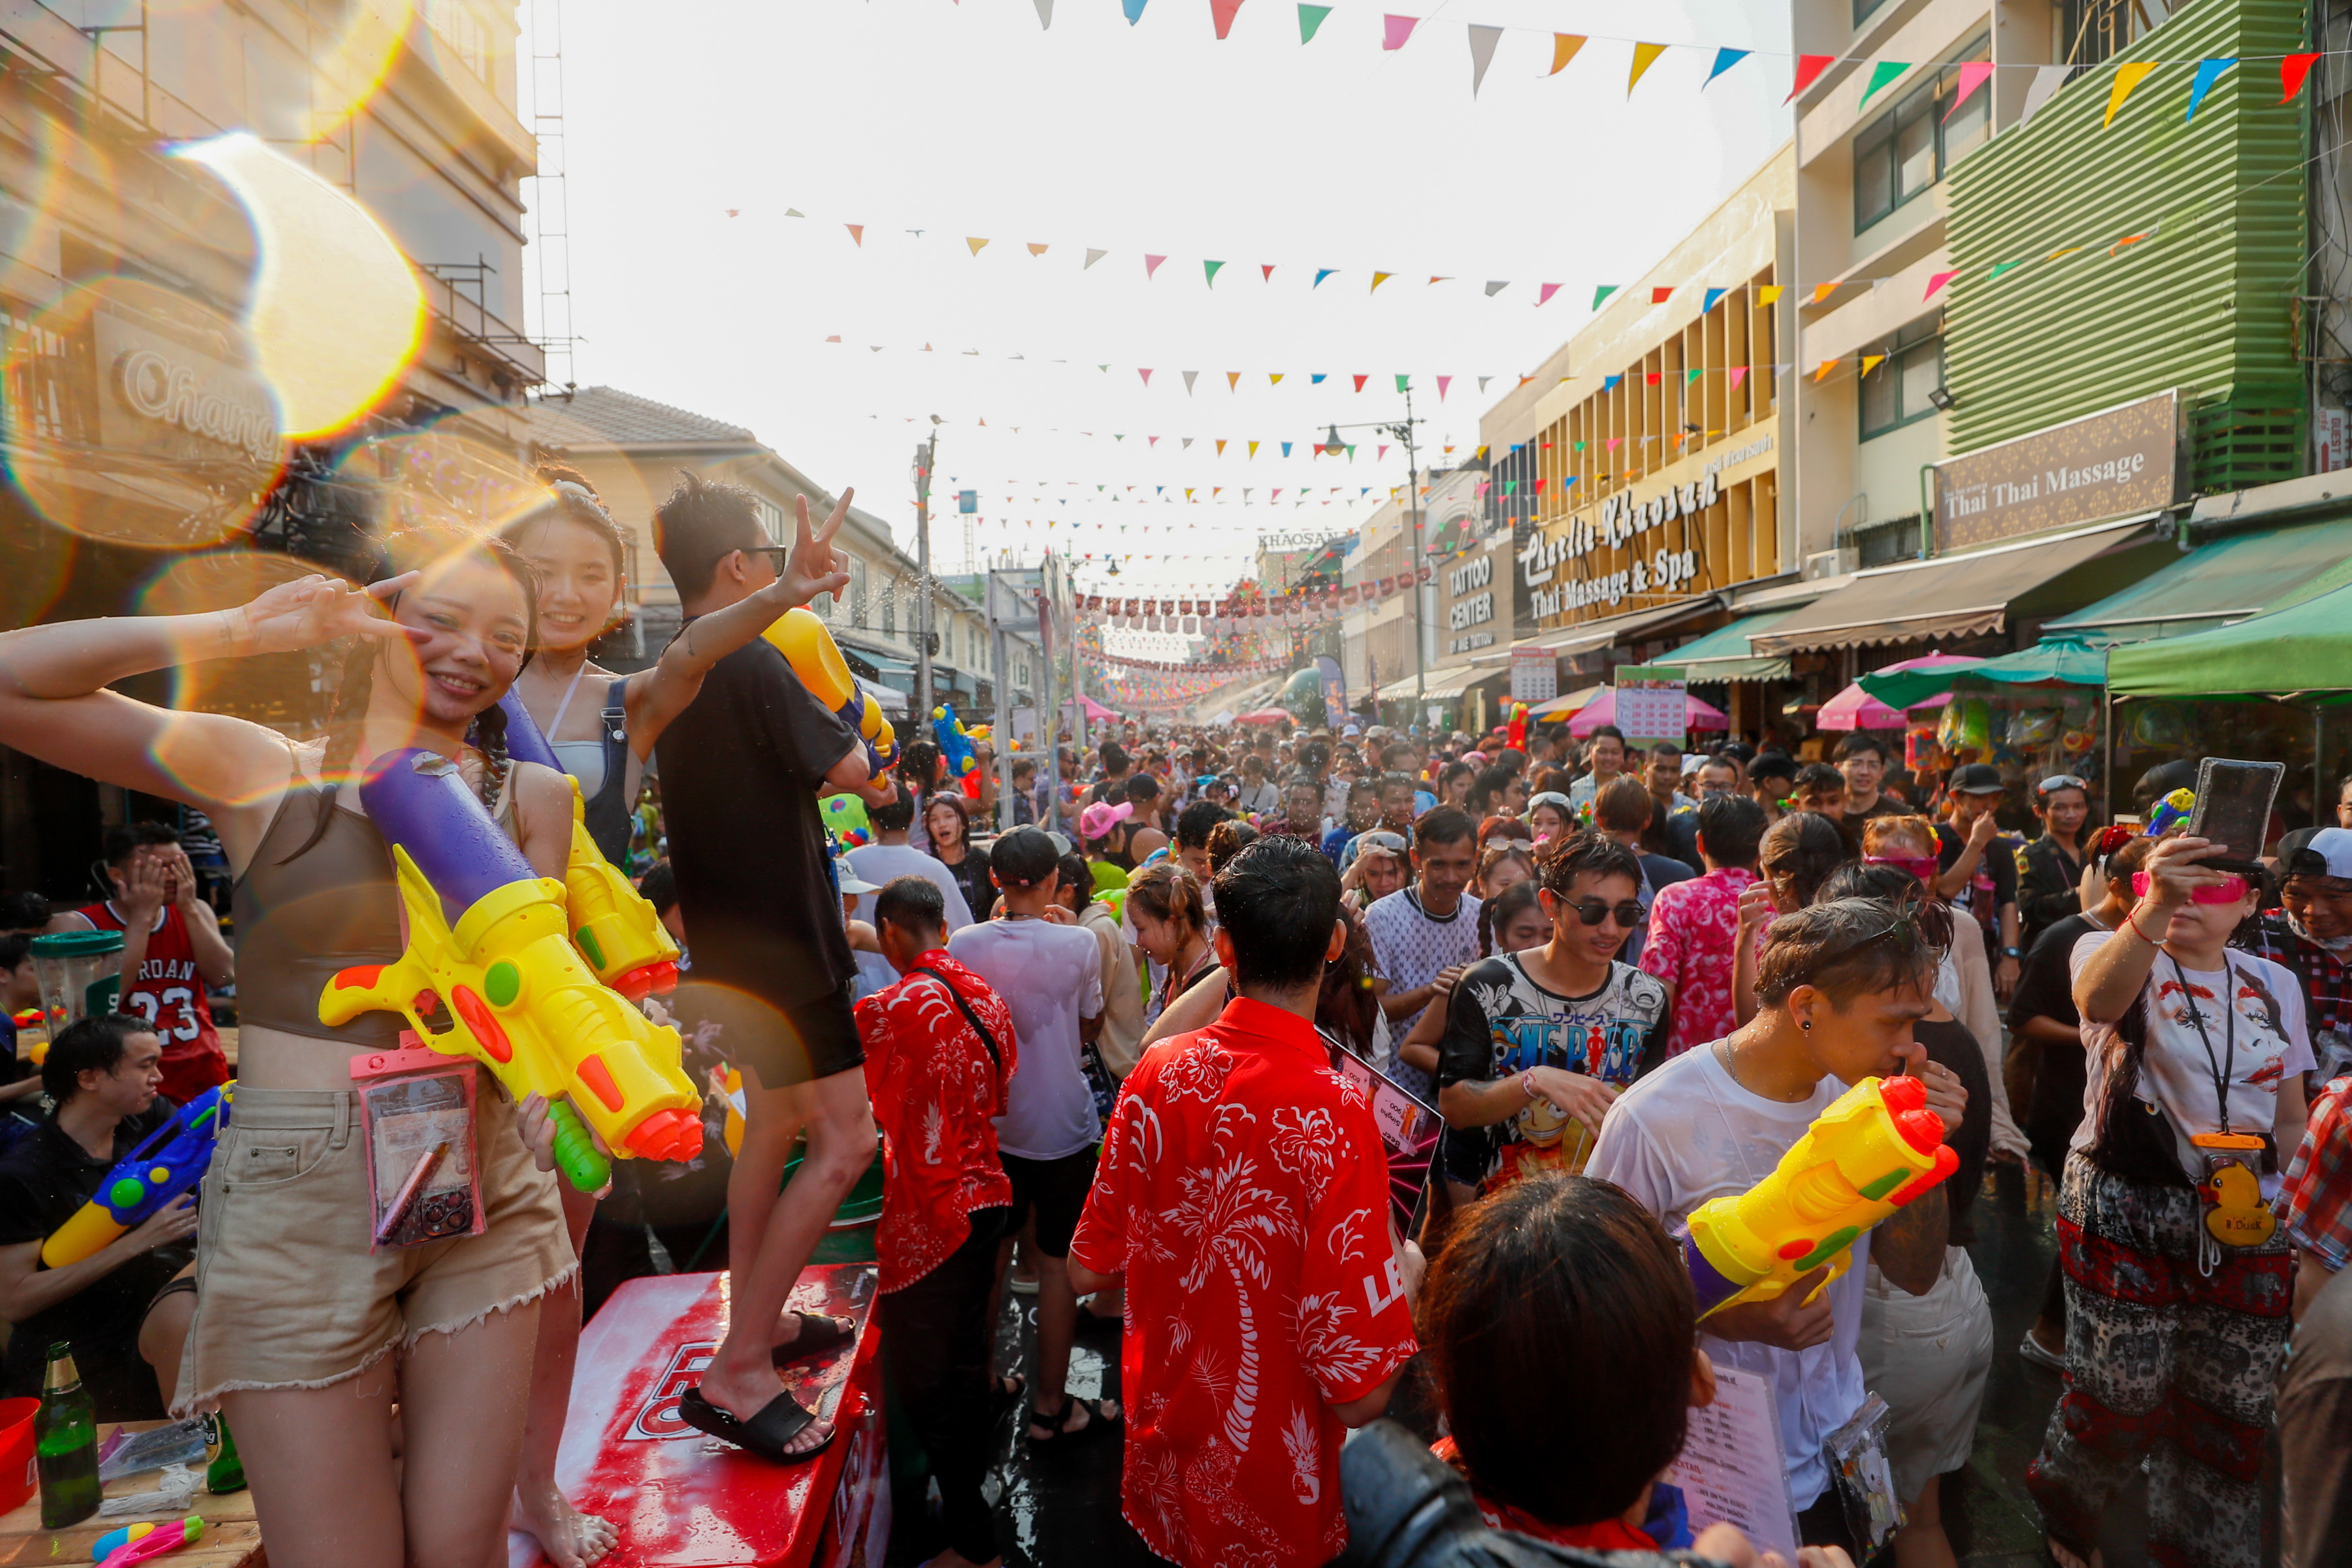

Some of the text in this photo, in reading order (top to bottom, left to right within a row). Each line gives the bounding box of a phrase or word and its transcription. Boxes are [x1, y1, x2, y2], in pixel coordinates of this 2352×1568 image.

[123, 350, 284, 461] Chang
[2331, 417, 2342, 453] GUEST
[1945, 490, 1987, 519] Thai
[1992, 474, 2038, 507] Thai
[2045, 451, 2144, 495] Massage
[1258, 531, 1337, 547] KHAOSAN
[1518, 473, 1718, 587] Charlie Khaosan
[1448, 555, 1490, 597] TATTOO
[1531, 548, 1697, 619] Thai Massage & Spa
[1450, 591, 1492, 631] CENTER
[139, 958, 195, 981] RDAN
[129, 987, 201, 1047] 23
[1552, 1012, 1605, 1026] ワンピース
[1491, 1022, 1561, 1070] ONE
[1380, 1108, 1401, 1127] Singha
[1385, 1099, 1402, 1115] 900.-
[1382, 1132, 1401, 1148] Beer
[1362, 1254, 1405, 1318] LE
